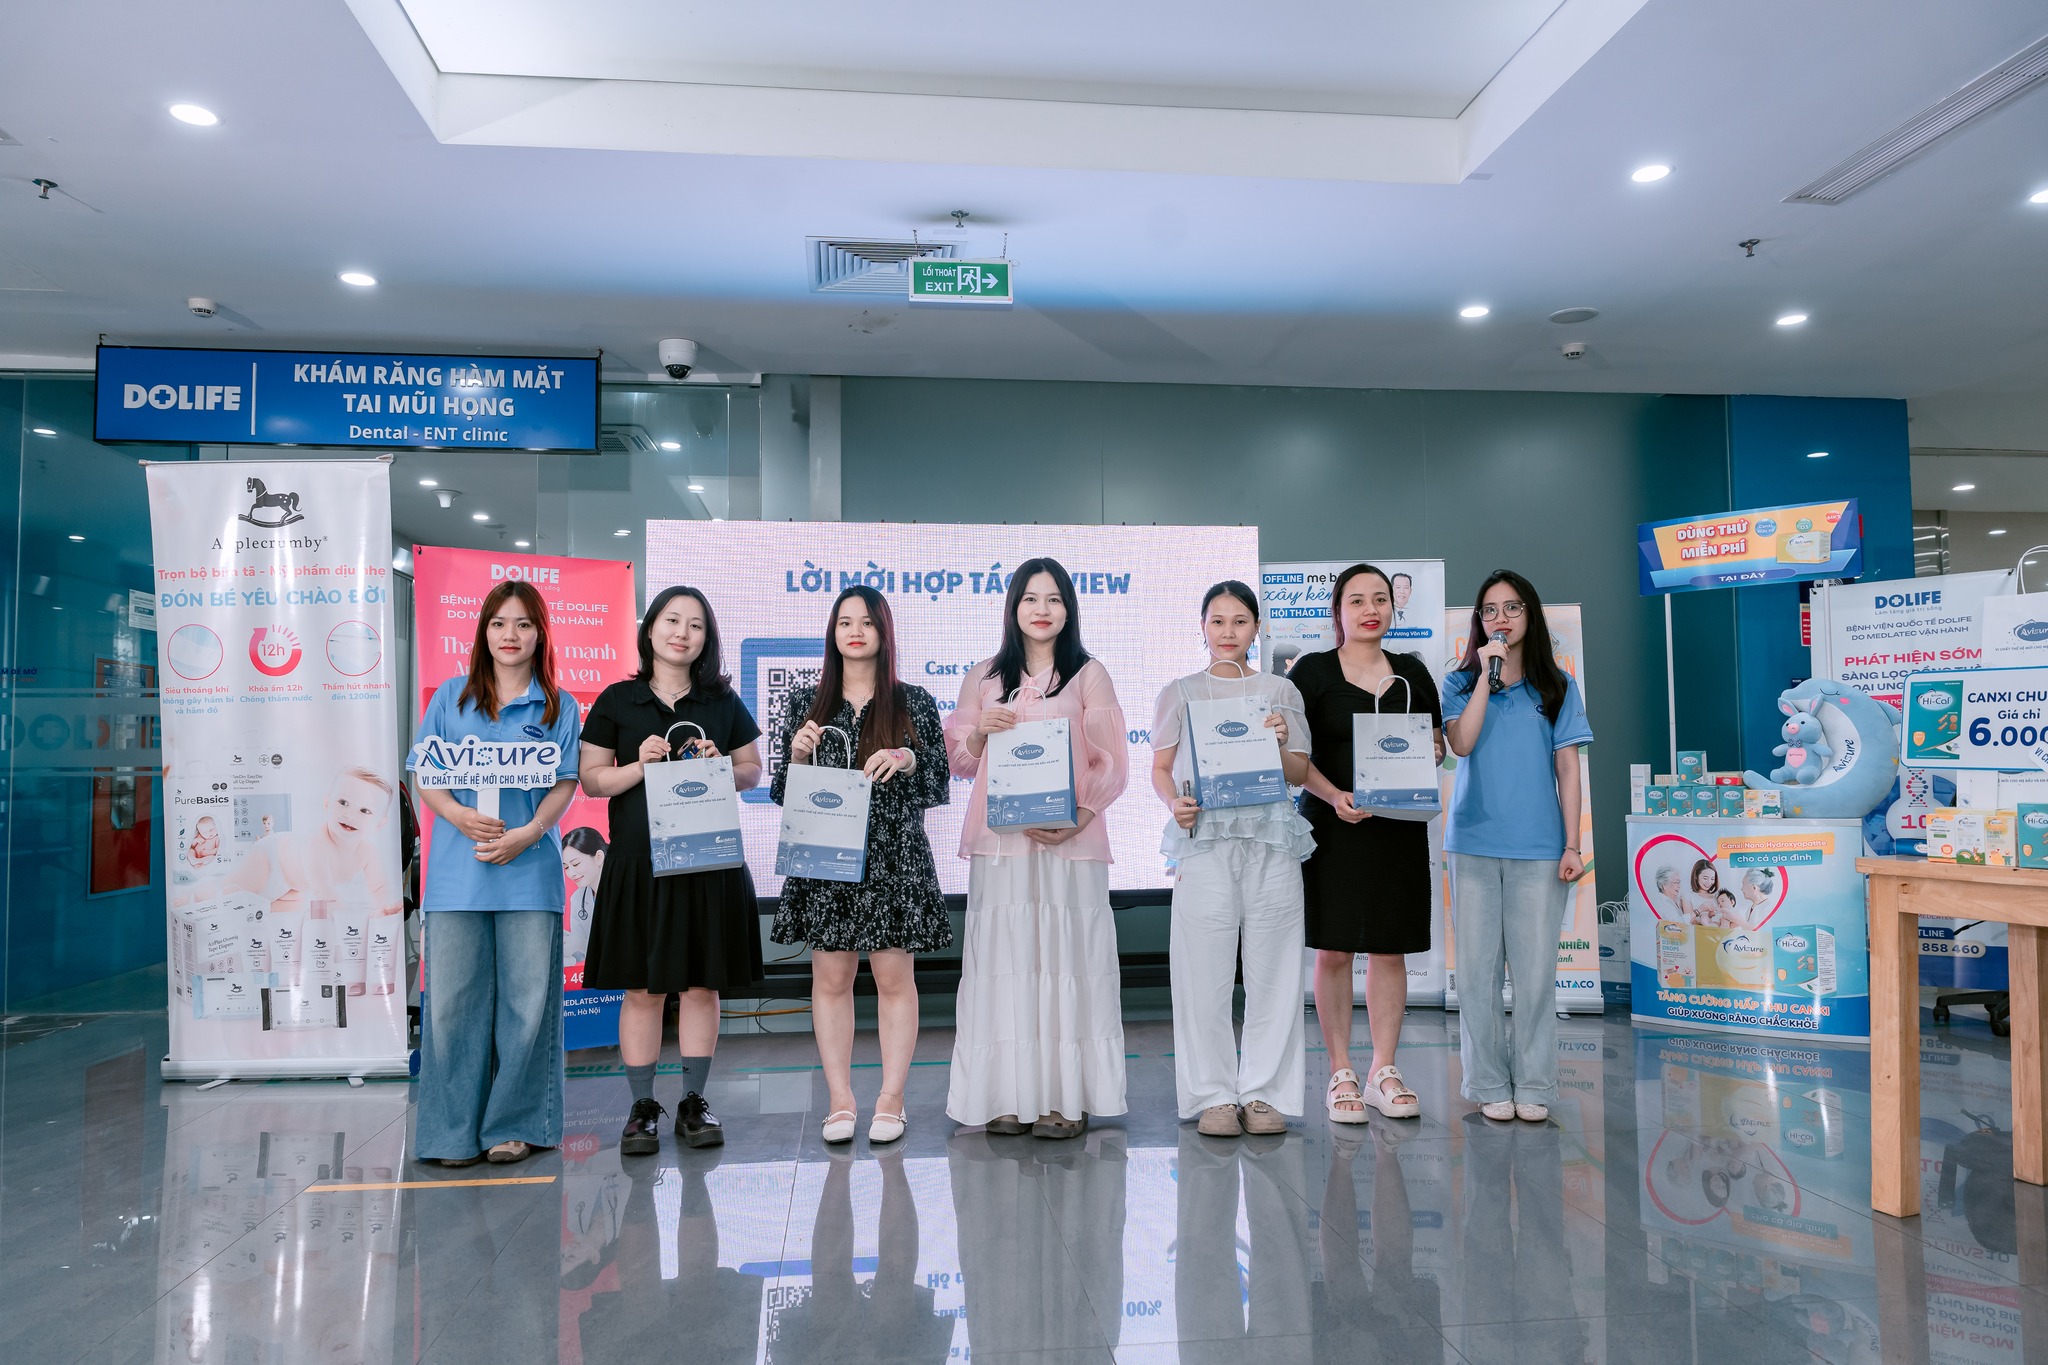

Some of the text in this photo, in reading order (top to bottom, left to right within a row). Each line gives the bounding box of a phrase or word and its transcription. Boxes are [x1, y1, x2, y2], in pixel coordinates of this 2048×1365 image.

[923, 265, 956, 276] LỐI THOÁT
[926, 282, 954, 292] EXIT
[294, 360, 564, 395] KHÁM RĂNG HÀM MẶT
[124, 384, 241, 410] DOLIFE
[343, 391, 515, 421] TAI MŨI HỌNG
[349, 425, 409, 442] Dental
[424, 427, 457, 442] ENT
[462, 426, 509, 443] clinic
[1678, 518, 1749, 541] DÙNG THỬ
[1682, 538, 1746, 560] MIỄN PHÍ
[158, 569, 186, 582] Trọn
[190, 567, 207, 578] bộ
[242, 566, 256, 577] tã
[335, 564, 355, 578] dịu
[491, 564, 559, 584] DOLIFE
[787, 560, 831, 592] LỜI
[902, 571, 963, 601] HỢP
[1264, 574, 1326, 584] OFFLINE mẹ
[1719, 572, 1766, 583] TẠI ĐÂY
[161, 590, 202, 608] ĐÓN
[211, 588, 236, 606] BÉ
[242, 588, 277, 606] YÊU
[286, 586, 342, 606] CHÀO
[440, 594, 476, 606] BỆNH
[566, 602, 608, 612] DOLIFE
[1263, 588, 1302, 606] xây
[1875, 590, 1941, 609] DOLIFE
[448, 610, 603, 626] DO ẬN HÀNH
[1271, 607, 1288, 618] HỘI
[1846, 616, 1972, 632] BỆNH VIỆN QUỐC TẾ DOLIFE
[2020, 627, 2048, 636] Avisur
[1867, 630, 1917, 640] MEDLATEC
[1918, 627, 1938, 636] VẬN
[1940, 625, 1968, 634] HÀNH
[262, 644, 284, 656] 12h
[565, 644, 616, 663] mạnh
[1844, 647, 1982, 666] PHÁT HIỆN SỚM
[570, 666, 600, 684] vẹn
[925, 660, 959, 675] Cast
[1842, 668, 1878, 681] SÀNG
[1882, 670, 1908, 682] LỌC
[288, 684, 303, 692] 12h
[1922, 696, 1952, 706] Hi-Cal
[1968, 692, 2012, 703] CANXI
[1998, 708, 2040, 720] Giá chỉ
[1221, 726, 1246, 734] Avisure
[1017, 746, 1042, 756] Avisure
[1383, 740, 1408, 748] Avisure
[420, 740, 556, 771] Avisure
[1832, 739, 1854, 772] Avisure
[422, 772, 552, 787] VI CHẤT THẾ HỆ MỚI CHO MẸ VÀ BÉ
[679, 784, 706, 794] Avisure
[174, 796, 230, 804] PureBasics
[815, 795, 840, 804] Avisure
[1745, 841, 1764, 849] Nano
[1737, 853, 1812, 864] cho cả gia đình
[1734, 943, 1764, 952] Avisure
[1782, 940, 1806, 948] Hi-Cal
[1922, 943, 1980, 954] 858 460
[1657, 990, 1688, 1003] TĂNG
[1689, 994, 1730, 1008] CƯỜNG
[1734, 997, 1760, 1011] HẤP
[1790, 1004, 1830, 1016] CANXI
[1668, 1006, 1818, 1030] GIÚP XƯƠNG RĂNG CHẮC KHỎE
